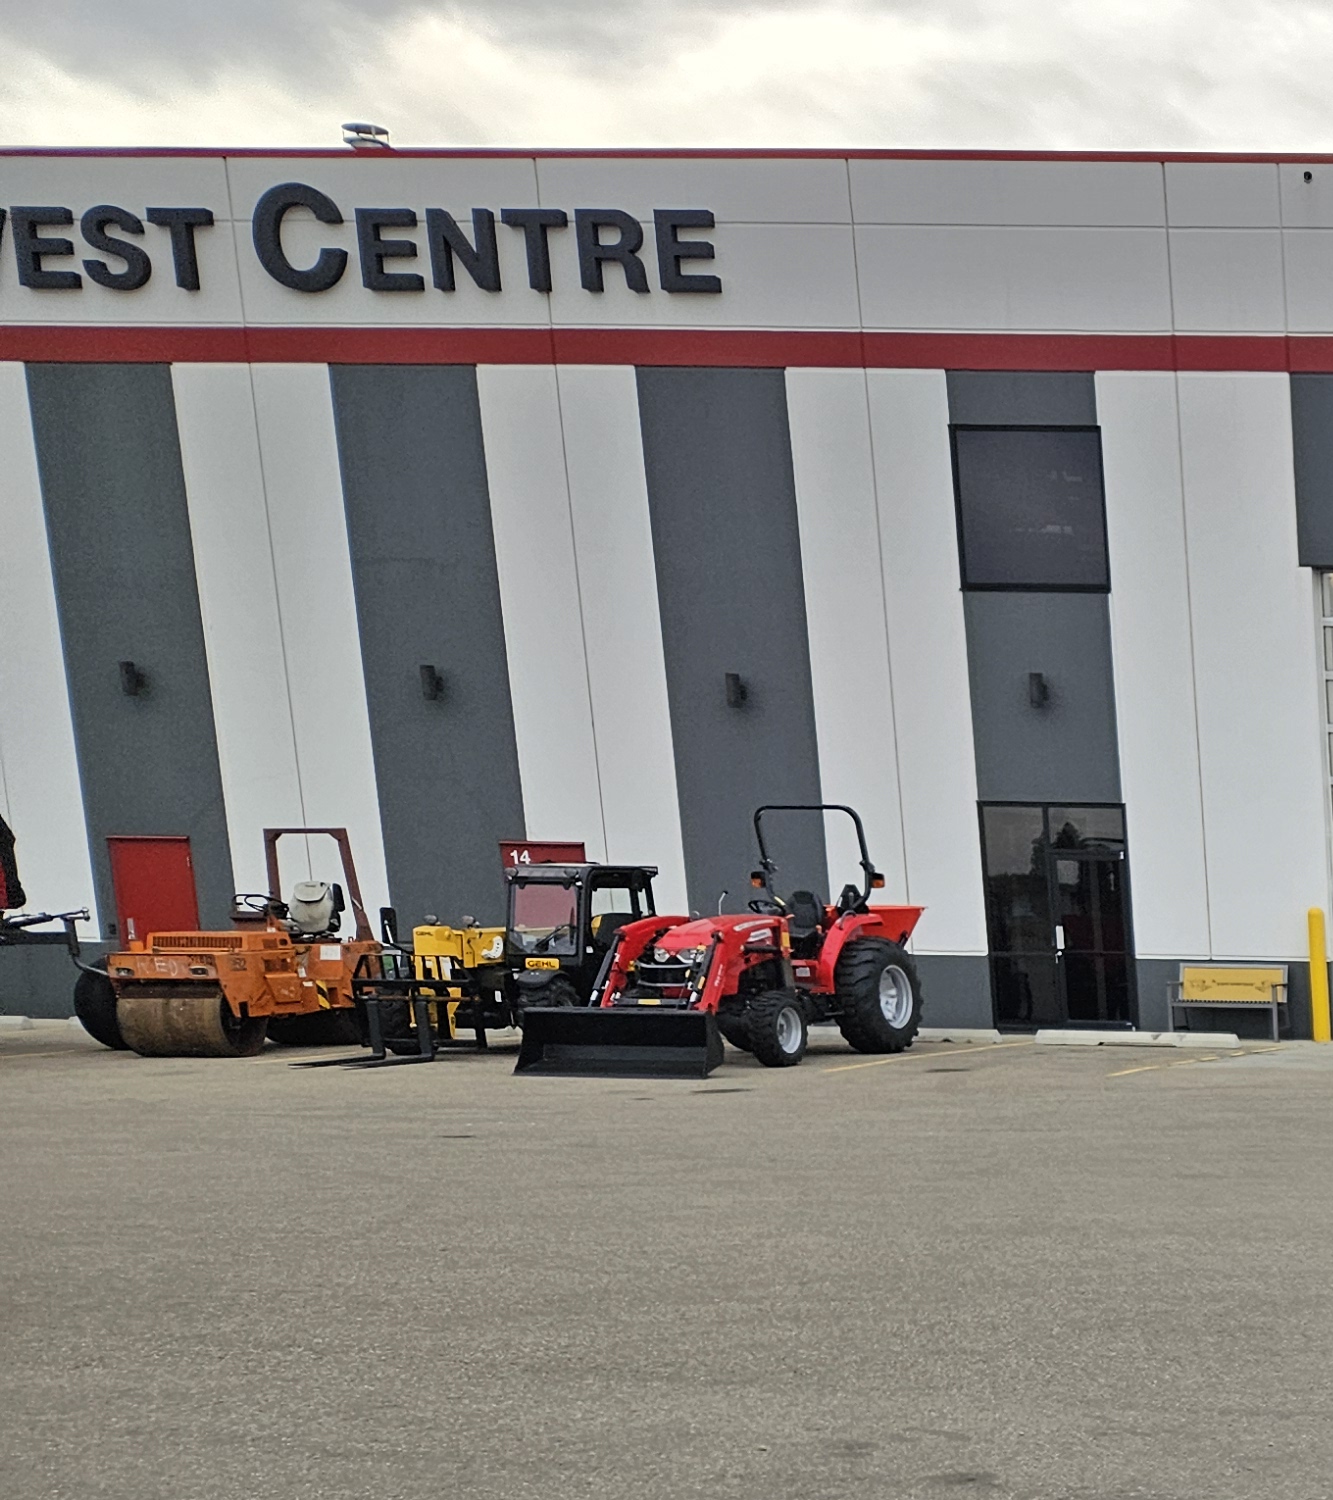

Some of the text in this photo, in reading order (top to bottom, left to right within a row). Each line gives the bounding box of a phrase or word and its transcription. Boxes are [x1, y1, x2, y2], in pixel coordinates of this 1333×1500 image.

[0, 182, 722, 295] EST CENTRE
[510, 849, 531, 865] 14
[527, 960, 556, 969] GEHL
